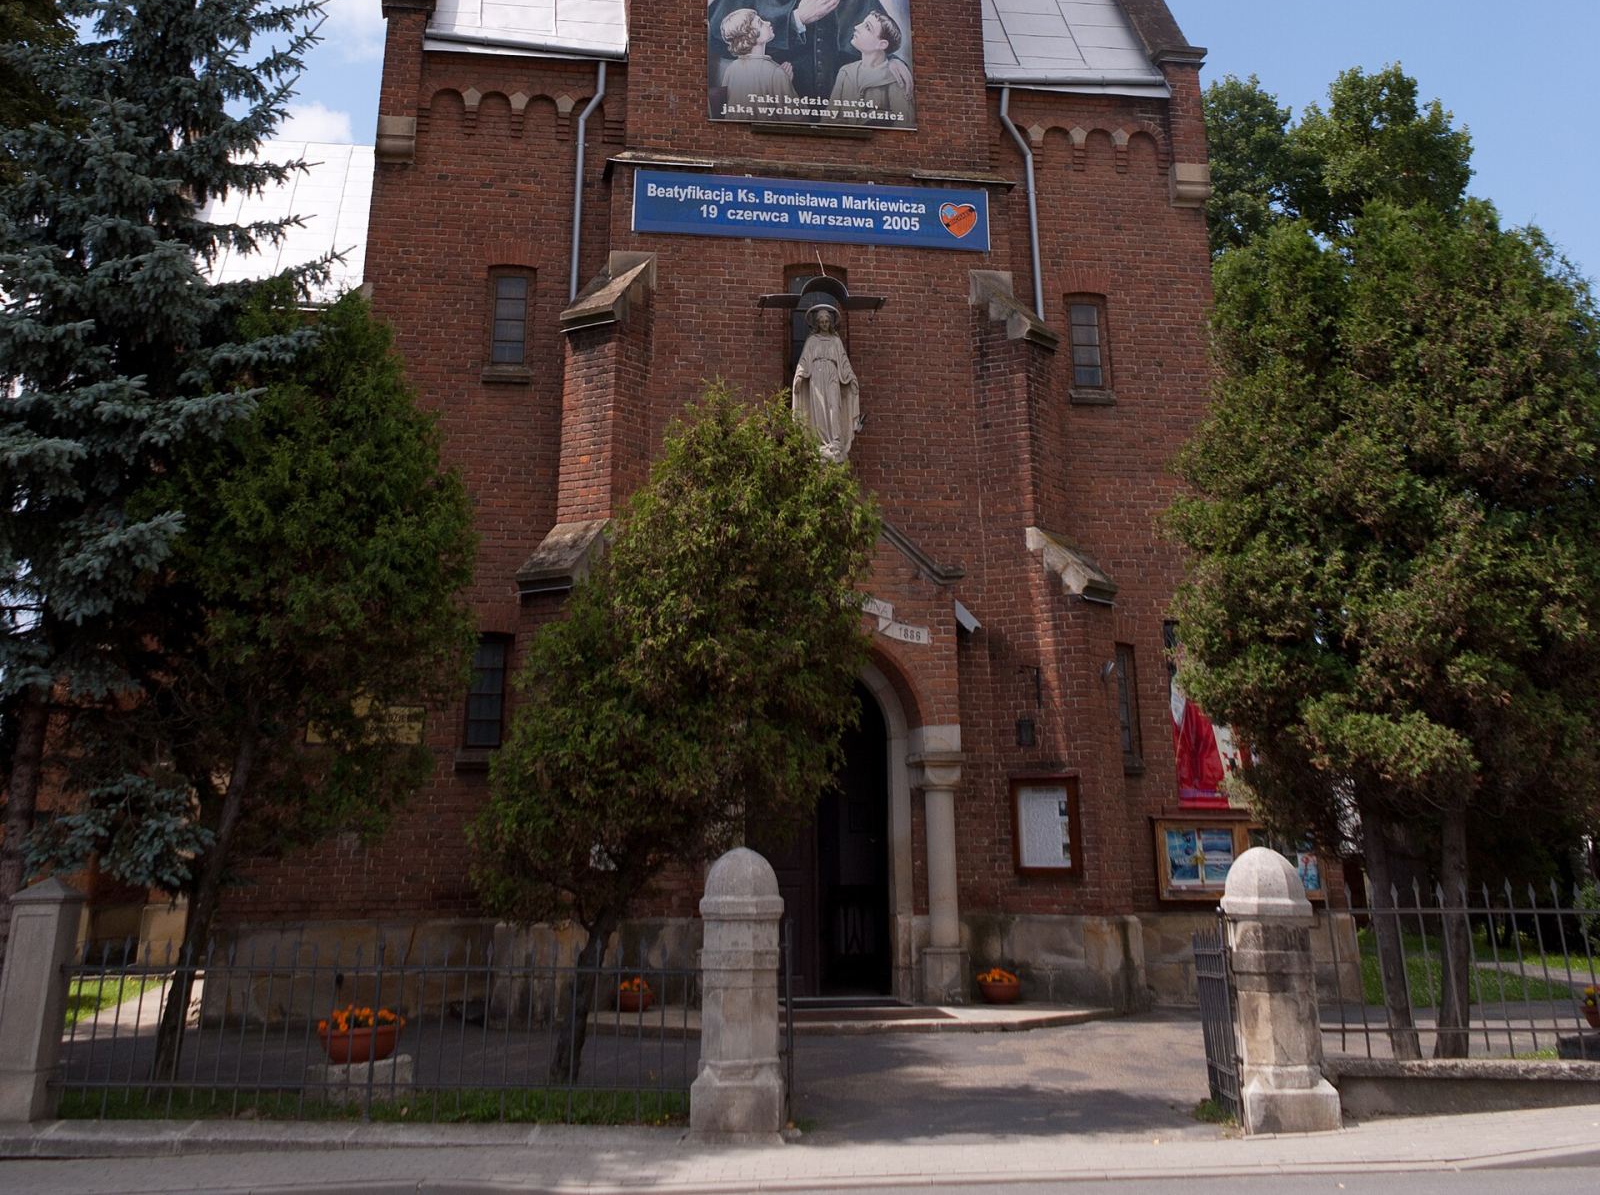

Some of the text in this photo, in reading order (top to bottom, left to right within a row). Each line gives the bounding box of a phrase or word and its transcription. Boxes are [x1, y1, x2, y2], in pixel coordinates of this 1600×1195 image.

[720, 103, 905, 121] jaką wychowamy młodzież
[747, 93, 879, 110] Taki będzie naród,
[647, 183, 926, 214] Beatyfikacja Ks. Bronisława Markiewicza
[700, 204, 920, 231] 19 czerwca Warszawa 2005
